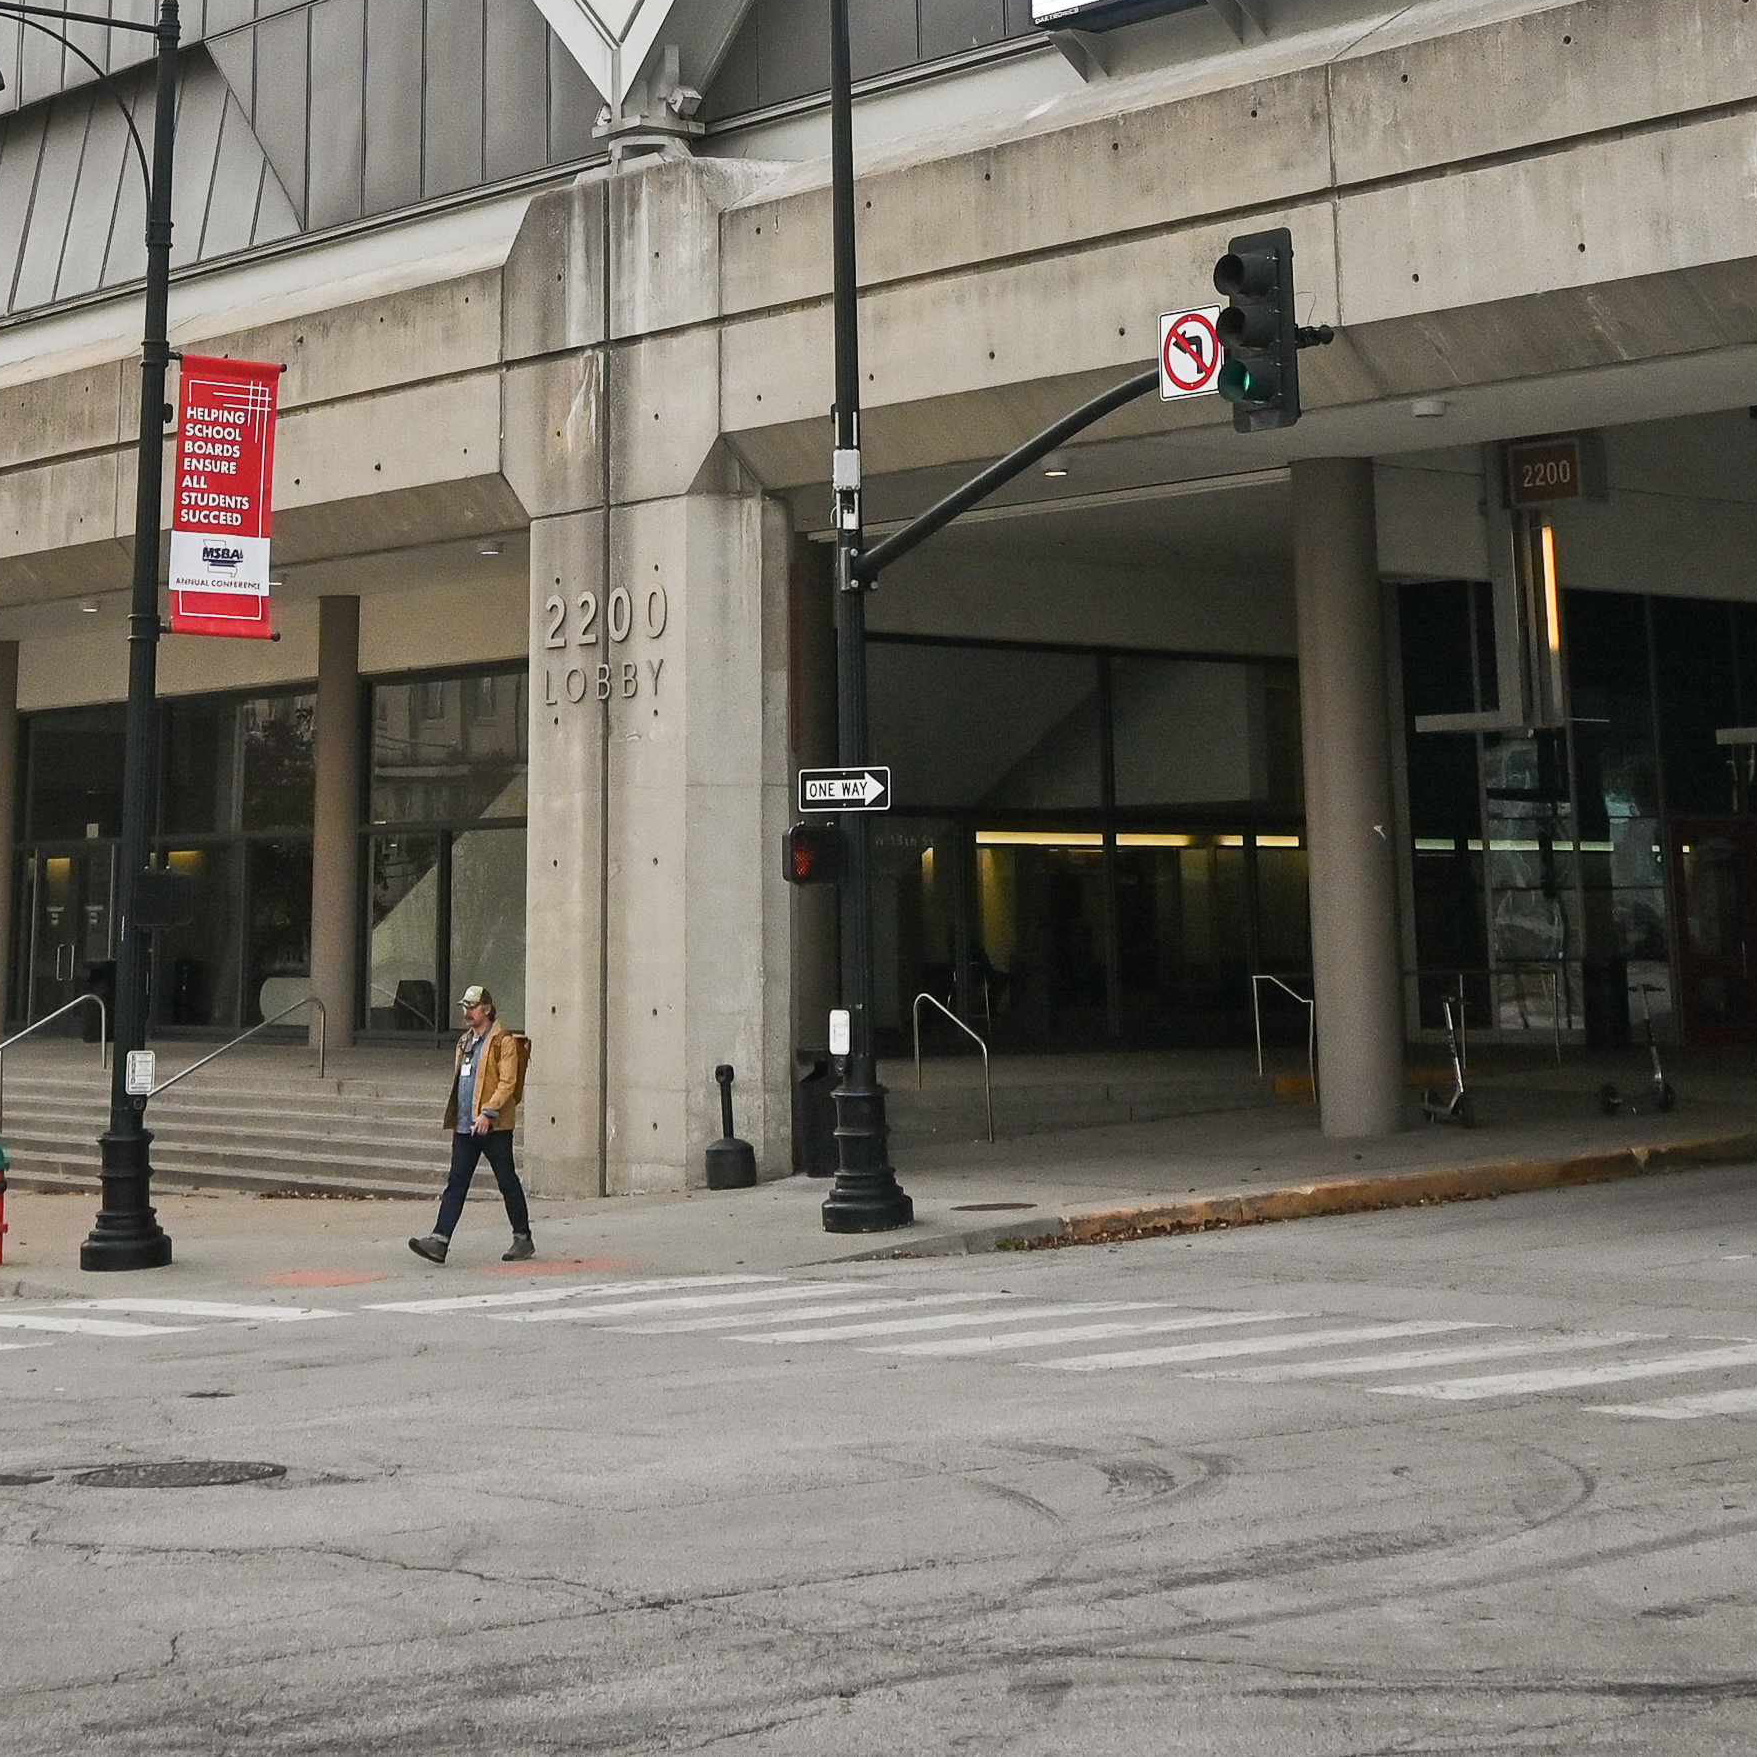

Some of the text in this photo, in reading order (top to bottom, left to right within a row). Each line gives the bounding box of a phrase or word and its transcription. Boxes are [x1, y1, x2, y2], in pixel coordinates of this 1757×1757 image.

[186, 406, 246, 425] HELPING
[184, 422, 242, 441] SCHOOL
[184, 440, 241, 458] BOARDS
[183, 457, 237, 475] ENSURE
[1522, 459, 1572, 489] 2200
[181, 474, 208, 489] ALL
[180, 491, 250, 510] STUDENTS
[180, 508, 242, 526] SUCCEED
[203, 546, 240, 560] MSBA
[175, 577, 261, 590] ANNUAL CONFERENCE
[544, 582, 668, 650] 2200
[544, 658, 664, 706] LOBBY
[809, 780, 868, 798] ONE WAY
